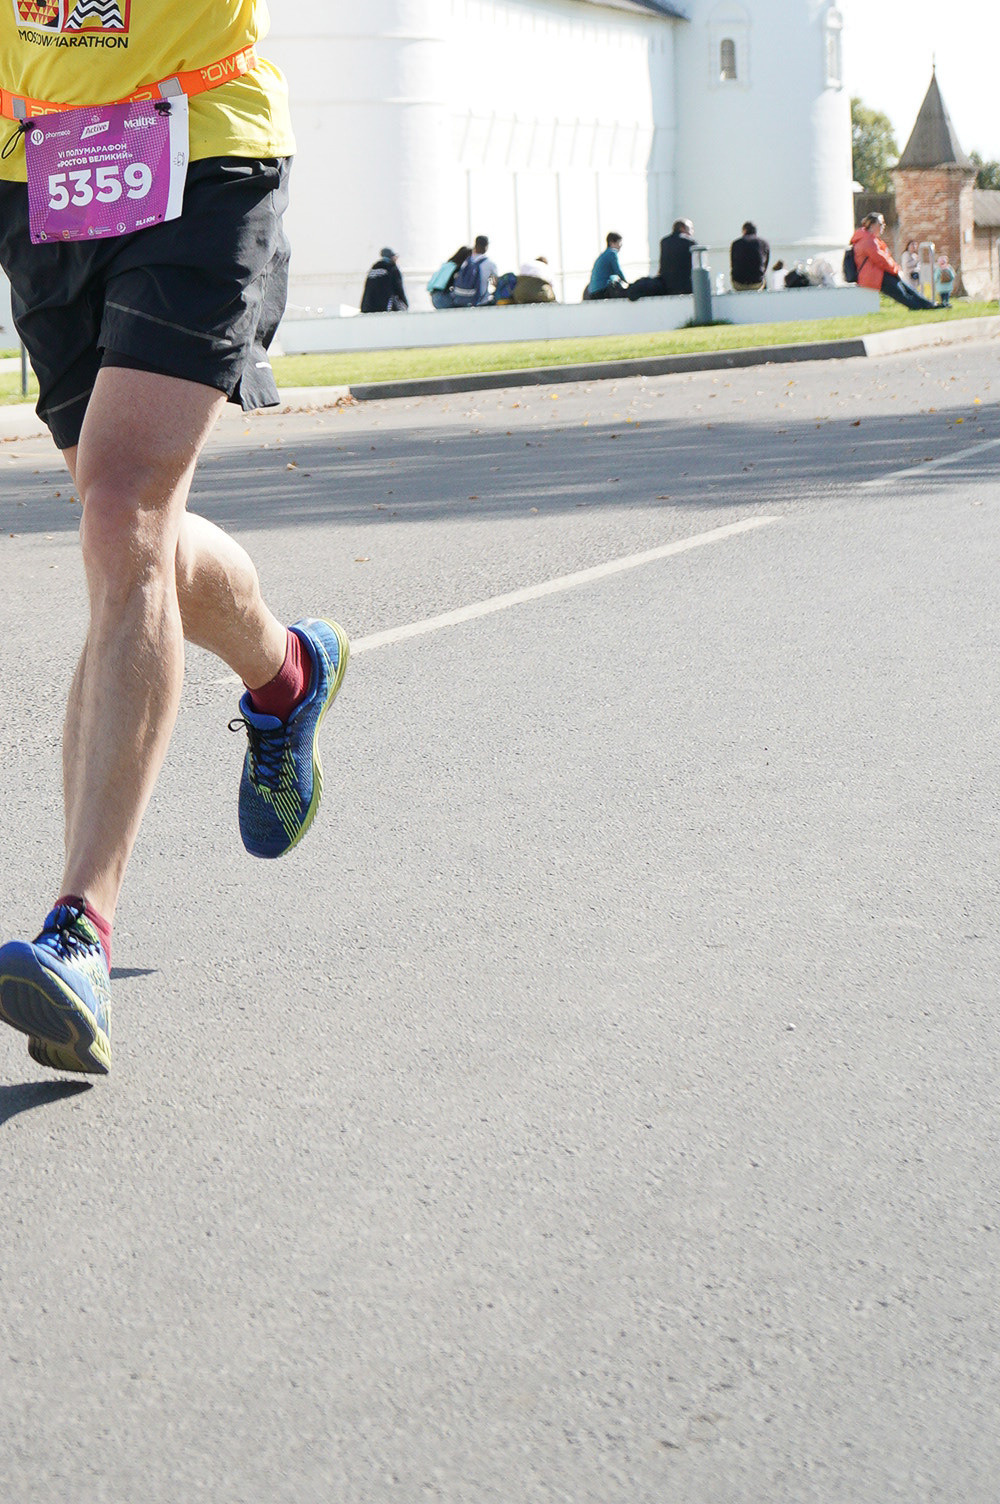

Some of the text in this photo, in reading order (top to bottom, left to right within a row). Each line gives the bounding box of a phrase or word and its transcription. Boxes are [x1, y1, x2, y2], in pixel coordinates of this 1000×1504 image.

[66, 142, 127, 157] ПОЛУМАРАФОН
[88, 150, 134, 164] ВЕЛИКИЙ»
[48, 162, 153, 211] 5359
